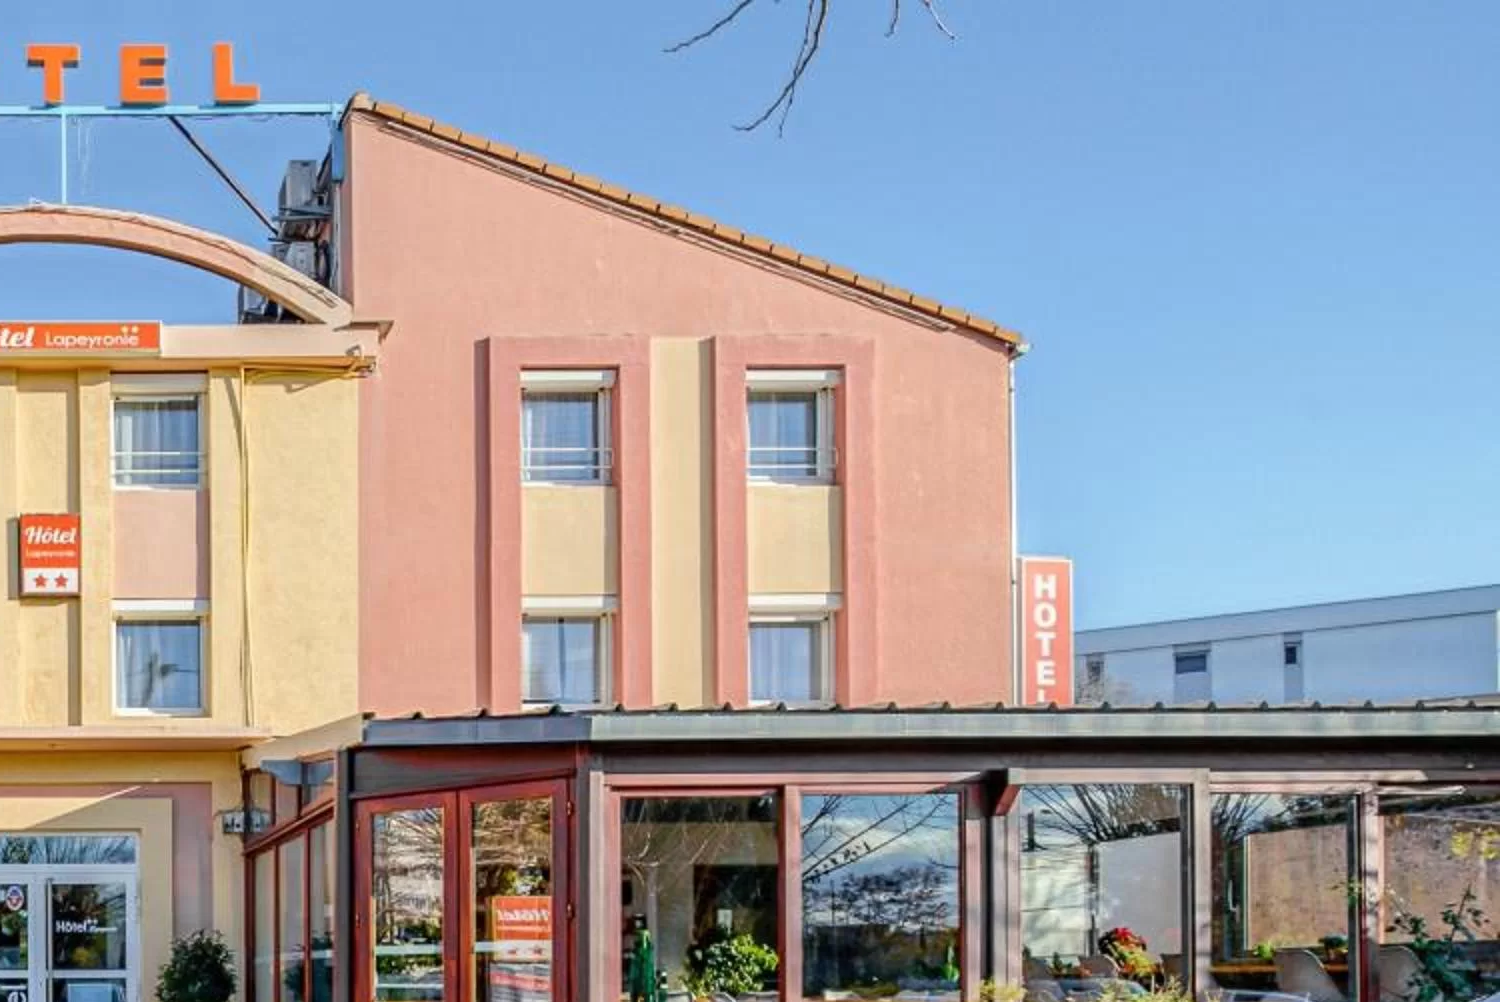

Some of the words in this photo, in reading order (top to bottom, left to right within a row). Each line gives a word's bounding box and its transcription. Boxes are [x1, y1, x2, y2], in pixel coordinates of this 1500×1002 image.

[45, 330, 139, 349] Lapeyronie
[25, 525, 77, 545] Hôtel
[55, 919, 88, 933] Hôtel
